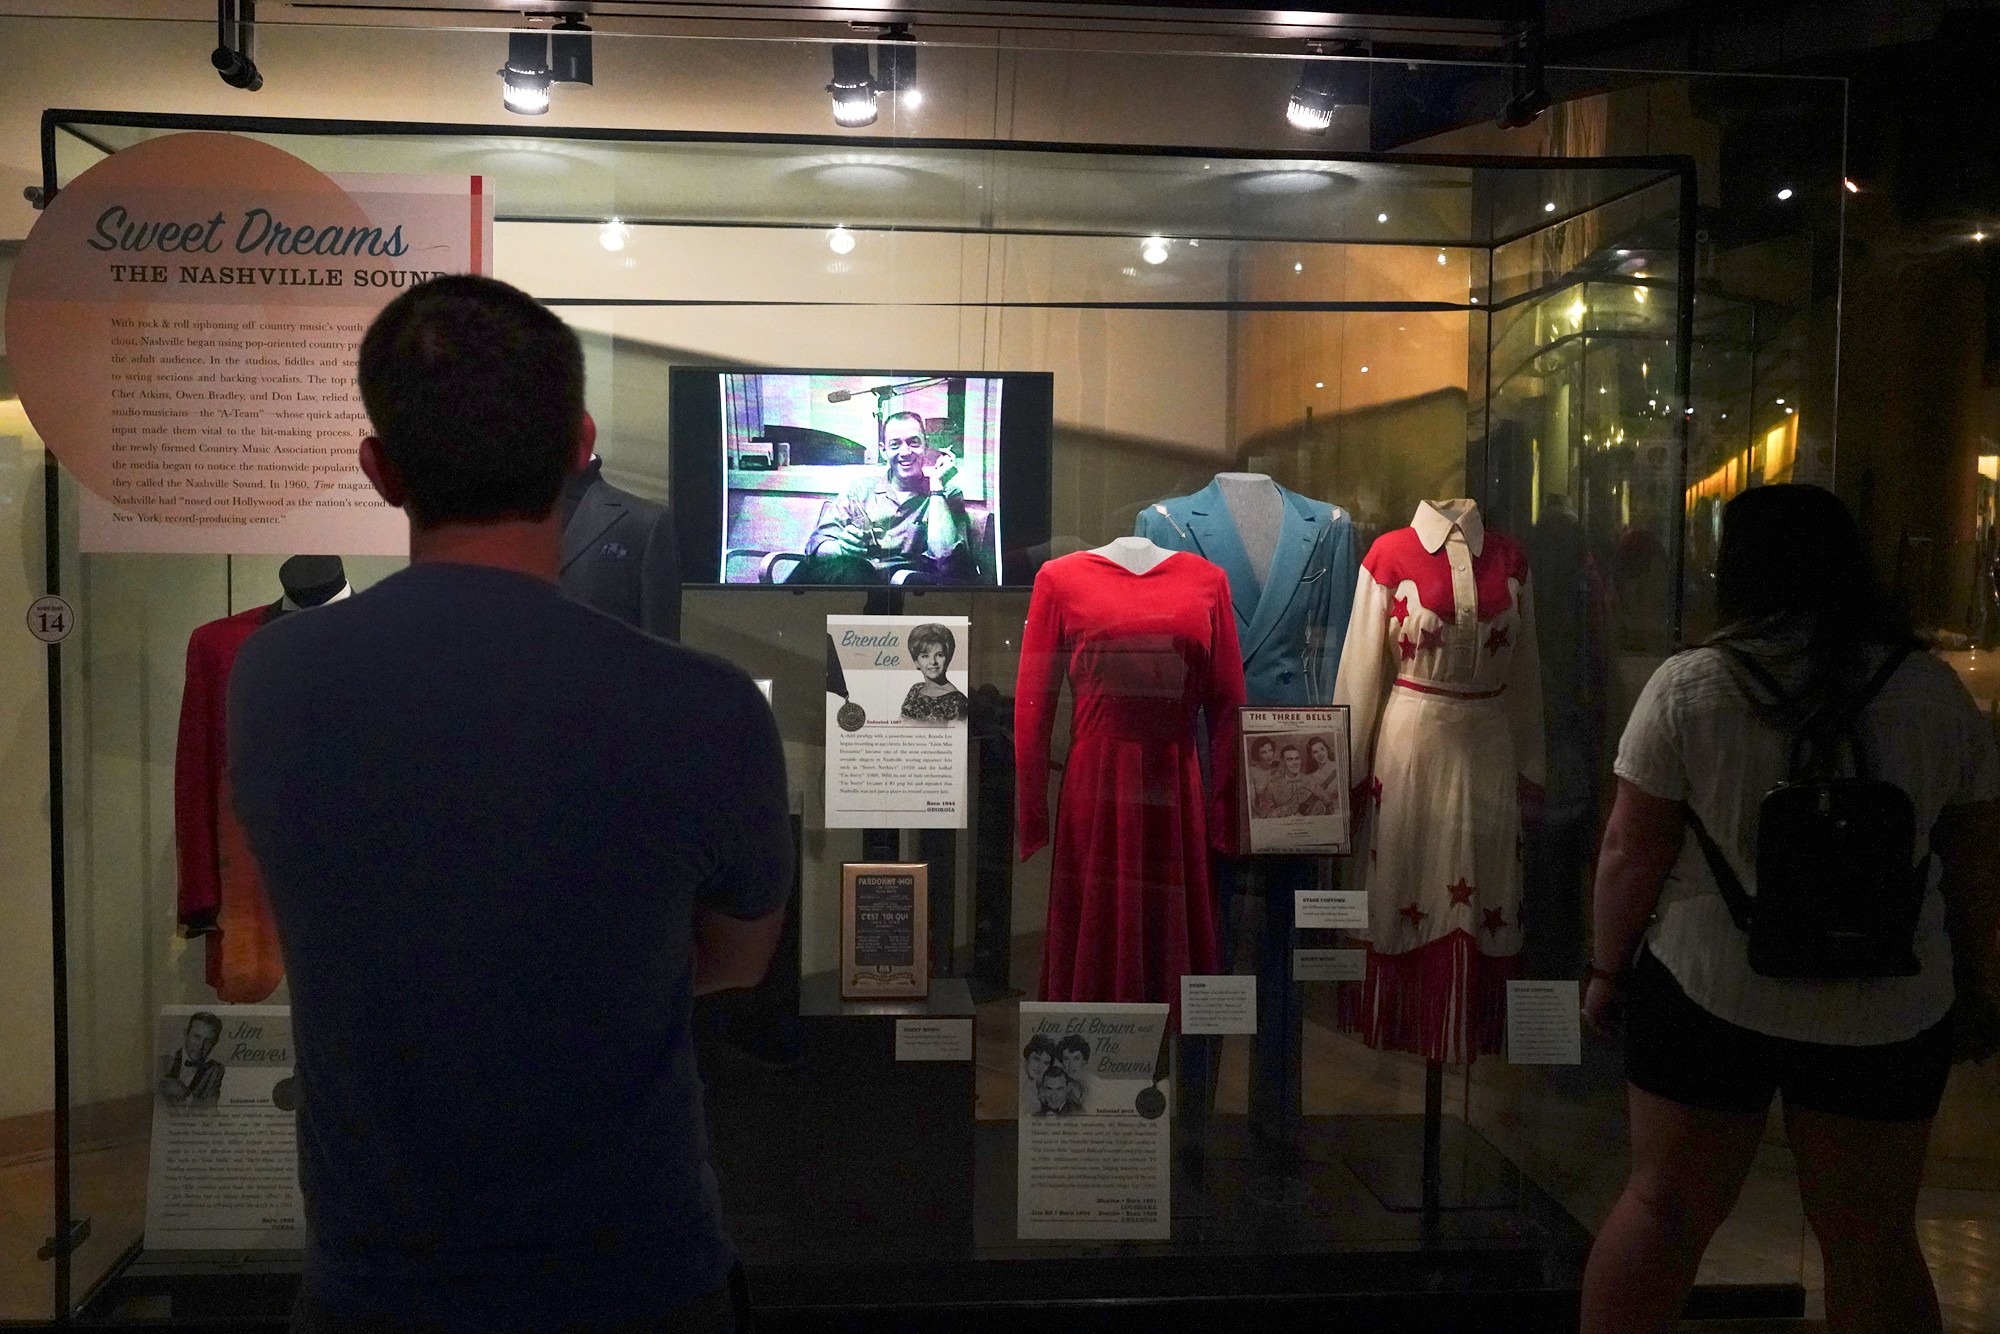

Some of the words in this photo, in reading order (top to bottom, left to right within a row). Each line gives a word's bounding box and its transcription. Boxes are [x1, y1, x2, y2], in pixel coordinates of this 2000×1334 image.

[87, 205, 226, 253] Sweet
[235, 208, 409, 257] Dreams
[110, 265, 168, 283] THE
[179, 266, 343, 286] NASHVILLE
[111, 318, 134, 327] With
[138, 319, 158, 328] rock
[162, 320, 170, 328] &
[174, 320, 189, 328] roll
[193, 320, 239, 331] siphoning
[242, 321, 256, 329] off
[260, 322, 295, 332] country
[337, 324, 362, 333] youth
[111, 337, 138, 346] clout,
[141, 338, 184, 346] Nashville
[187, 338, 215, 348] began
[219, 339, 242, 348] using
[246, 340, 306, 348] pop-oriented
[112, 355, 126, 363] the
[131, 355, 155, 363] adult
[160, 355, 205, 364] audience.
[210, 356, 220, 364] In
[245, 357, 280, 366] studios,
[285, 358, 315, 366] fiddles
[320, 358, 337, 366] and
[126, 372, 152, 382] string
[157, 373, 193, 381] sections
[220, 374, 256, 384] backing
[262, 375, 302, 383] vocalists.
[308, 375, 326, 383] The
[332, 377, 346, 386] top
[112, 390, 134, 398] Chet
[139, 390, 171, 400] Atkins,
[176, 391, 204, 399] Owen
[209, 391, 246, 401] Bradley,
[250, 392, 267, 400] and
[272, 392, 292, 400] Don
[297, 393, 318, 401] Law,
[112, 408, 140, 416] studio
[307, 411, 332, 420] quick
[334, 412, 368, 421] adapta
[112, 425, 136, 435] input
[142, 426, 167, 434] made
[173, 426, 196, 434] them
[202, 427, 222, 435] vital
[239, 428, 255, 436] the
[261, 428, 312, 437] hit-making
[317, 430, 352, 438] process.
[112, 443, 127, 451] the
[131, 443, 158, 454] newly
[161, 444, 195, 452] formed
[199, 444, 238, 455] Country
[242, 444, 270, 453] Music
[274, 445, 326, 454] Association
[331, 448, 360, 456] promo
[112, 461, 127, 469] the
[131, 461, 159, 469] media
[163, 461, 191, 472] began
[208, 462, 235, 470] notice
[258, 463, 308, 471] nationwide
[313, 463, 360, 473] popularity
[112, 479, 131, 488] they
[136, 479, 163, 487] called
[167, 479, 182, 487] the
[186, 479, 229, 488] Nashville
[233, 479, 265, 488] Sound.
[284, 481, 309, 490] 1960,
[315, 481, 335, 489] Time
[338, 482, 375, 491] magazi
[113, 496, 156, 504] Nashville
[159, 496, 176, 504] had
[233, 497, 283, 506] Hollywood
[299, 498, 312, 506] the
[316, 498, 351, 507] nation's
[354, 499, 385, 507] second
[113, 513, 133, 522] New
[165, 514, 246, 525] record-producing
[38, 613, 64, 632] 14
[841, 630, 900, 647] Brenda
[873, 650, 900, 666] Lee
[229, 1021, 263, 1040] Jim
[1032, 1017, 1060, 1033] Jim
[1065, 1018, 1086, 1033] Ed
[1088, 1018, 1136, 1034] Brown
[231, 1043, 288, 1061] Reeves
[1095, 1037, 1120, 1053] The
[1097, 1056, 1153, 1073] Browns
